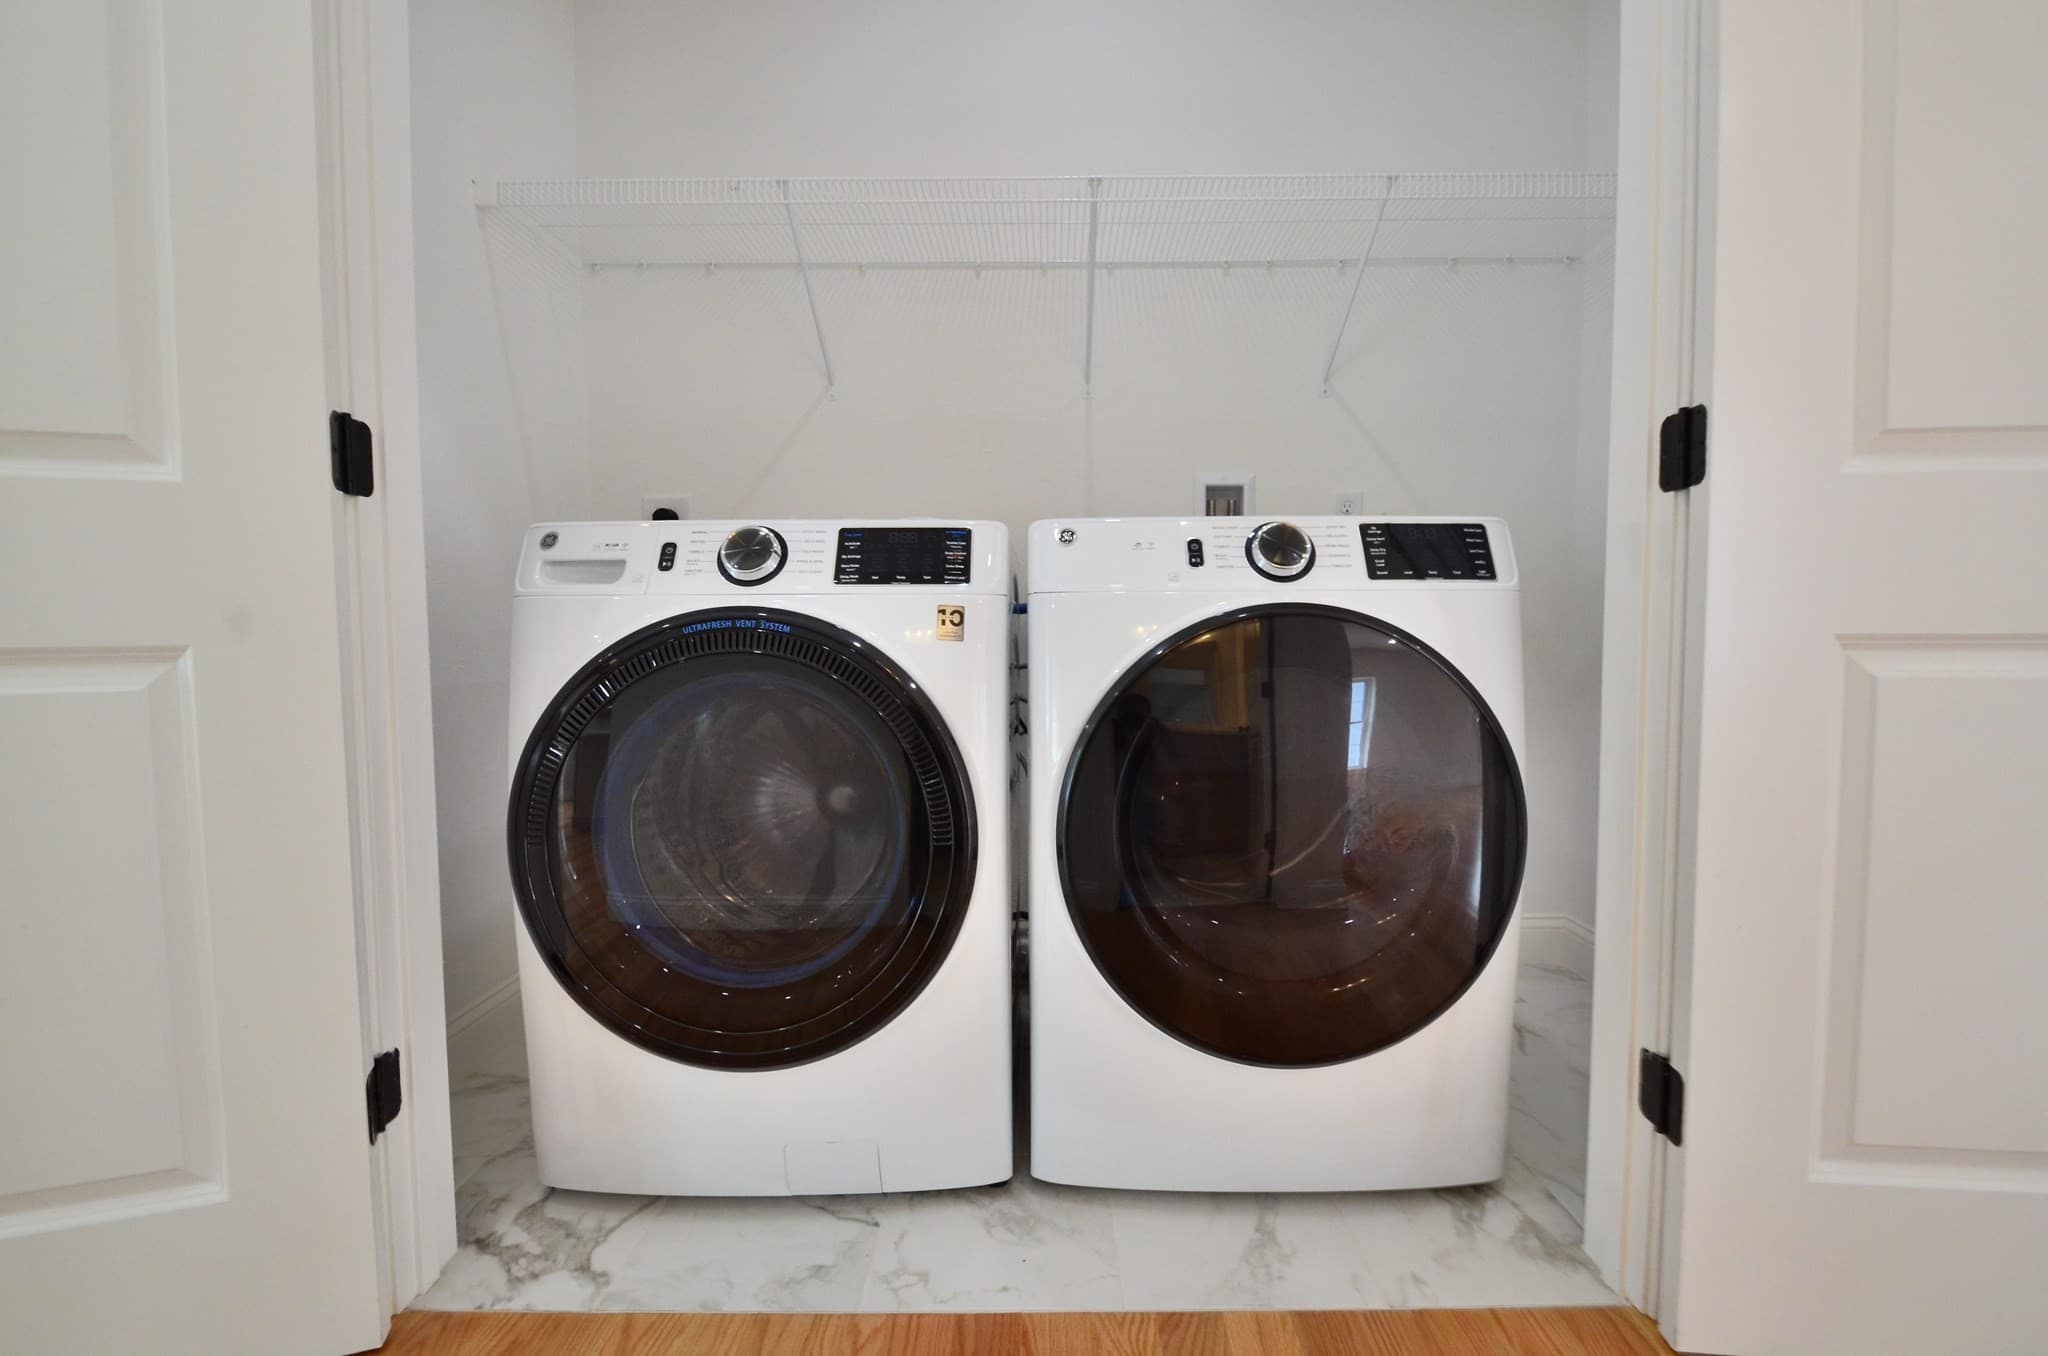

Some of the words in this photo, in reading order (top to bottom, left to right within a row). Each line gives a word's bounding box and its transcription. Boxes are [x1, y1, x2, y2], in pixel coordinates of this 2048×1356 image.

[682, 620, 732, 634] ULTRAFRESH
[735, 620, 756, 628] VENT
[760, 620, 791, 633] SYSTEM
